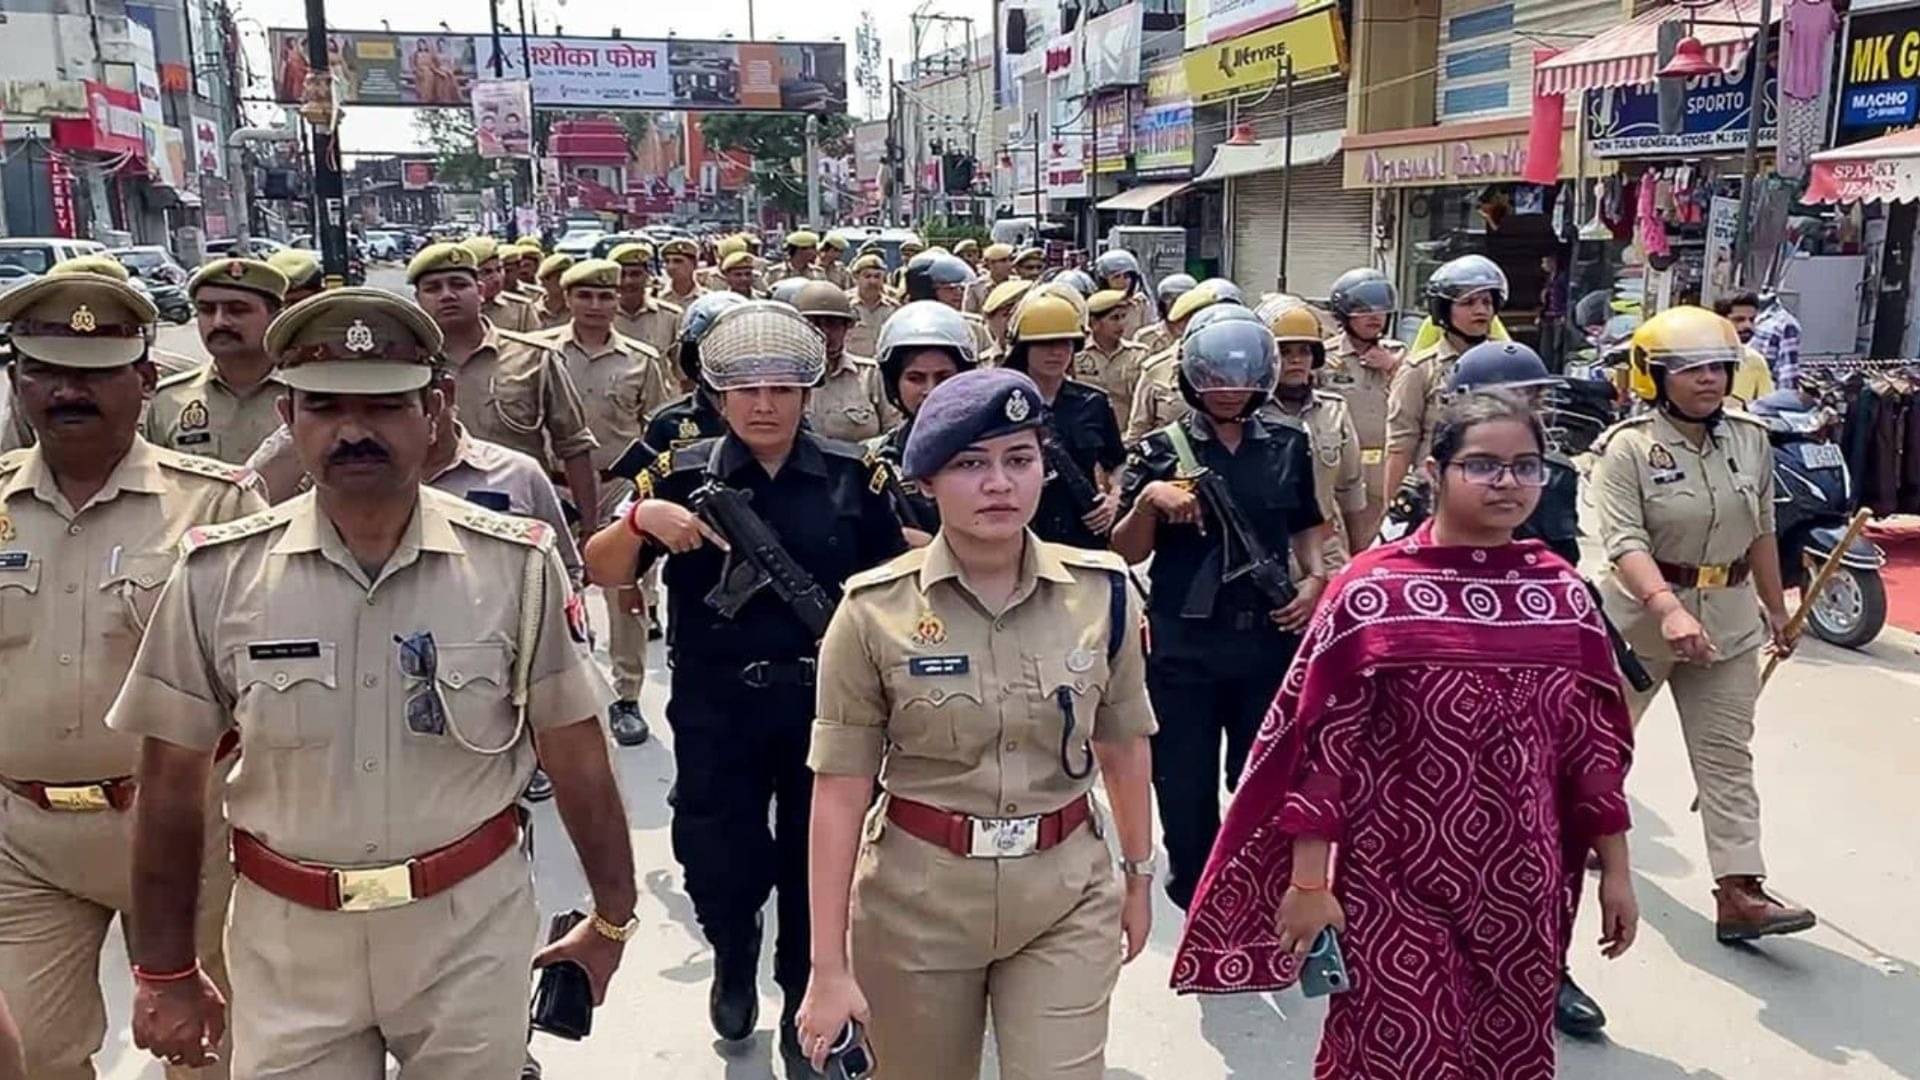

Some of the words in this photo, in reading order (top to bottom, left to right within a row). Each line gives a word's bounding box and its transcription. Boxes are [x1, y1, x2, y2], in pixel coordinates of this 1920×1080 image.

[604, 43, 657, 69] फोम
[1850, 33, 1895, 83] MK
[1898, 30, 1920, 79] G
[1687, 91, 1744, 114] SPORTO
[1852, 91, 1908, 109] MACHO
[1639, 135, 1678, 148] GENERAL
[1832, 160, 1899, 179] SPARKY
[1837, 177, 1897, 197] JEANS
